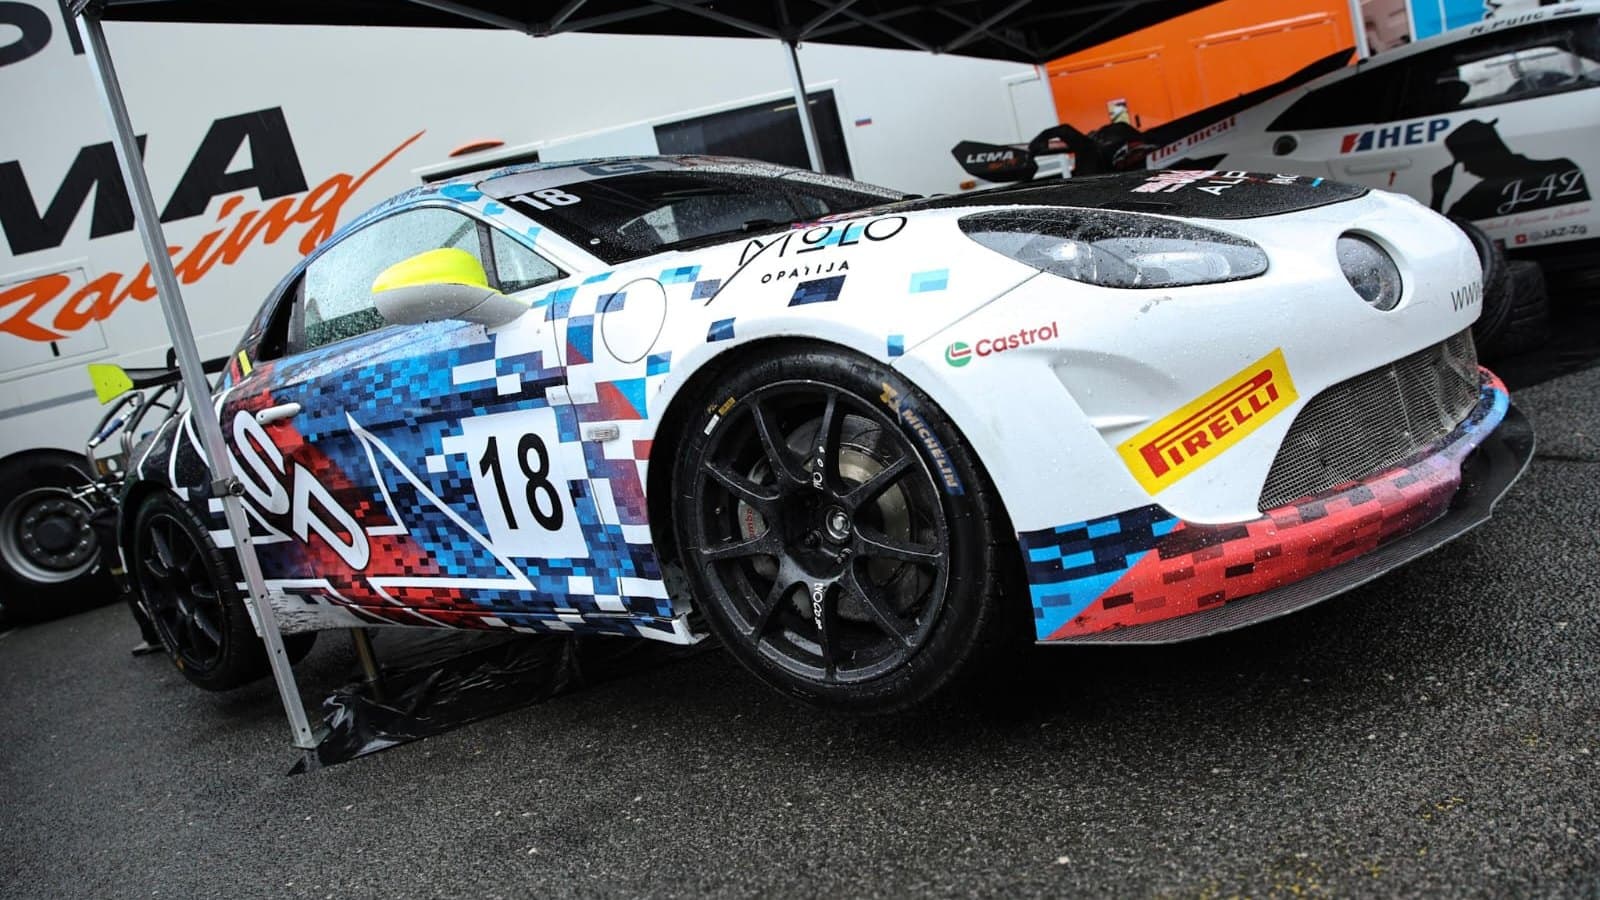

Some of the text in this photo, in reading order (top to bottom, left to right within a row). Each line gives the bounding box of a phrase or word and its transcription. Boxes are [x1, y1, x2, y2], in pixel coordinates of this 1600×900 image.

[1378, 119, 1450, 149] HEP
[966, 150, 1015, 164] LEMA
[509, 187, 582, 212] 18
[1496, 168, 1583, 214] JAZ
[976, 322, 1060, 358] Castrol
[1139, 368, 1280, 478] PIRELLI
[902, 409, 958, 489] MICHELIN
[479, 433, 564, 532] 18
